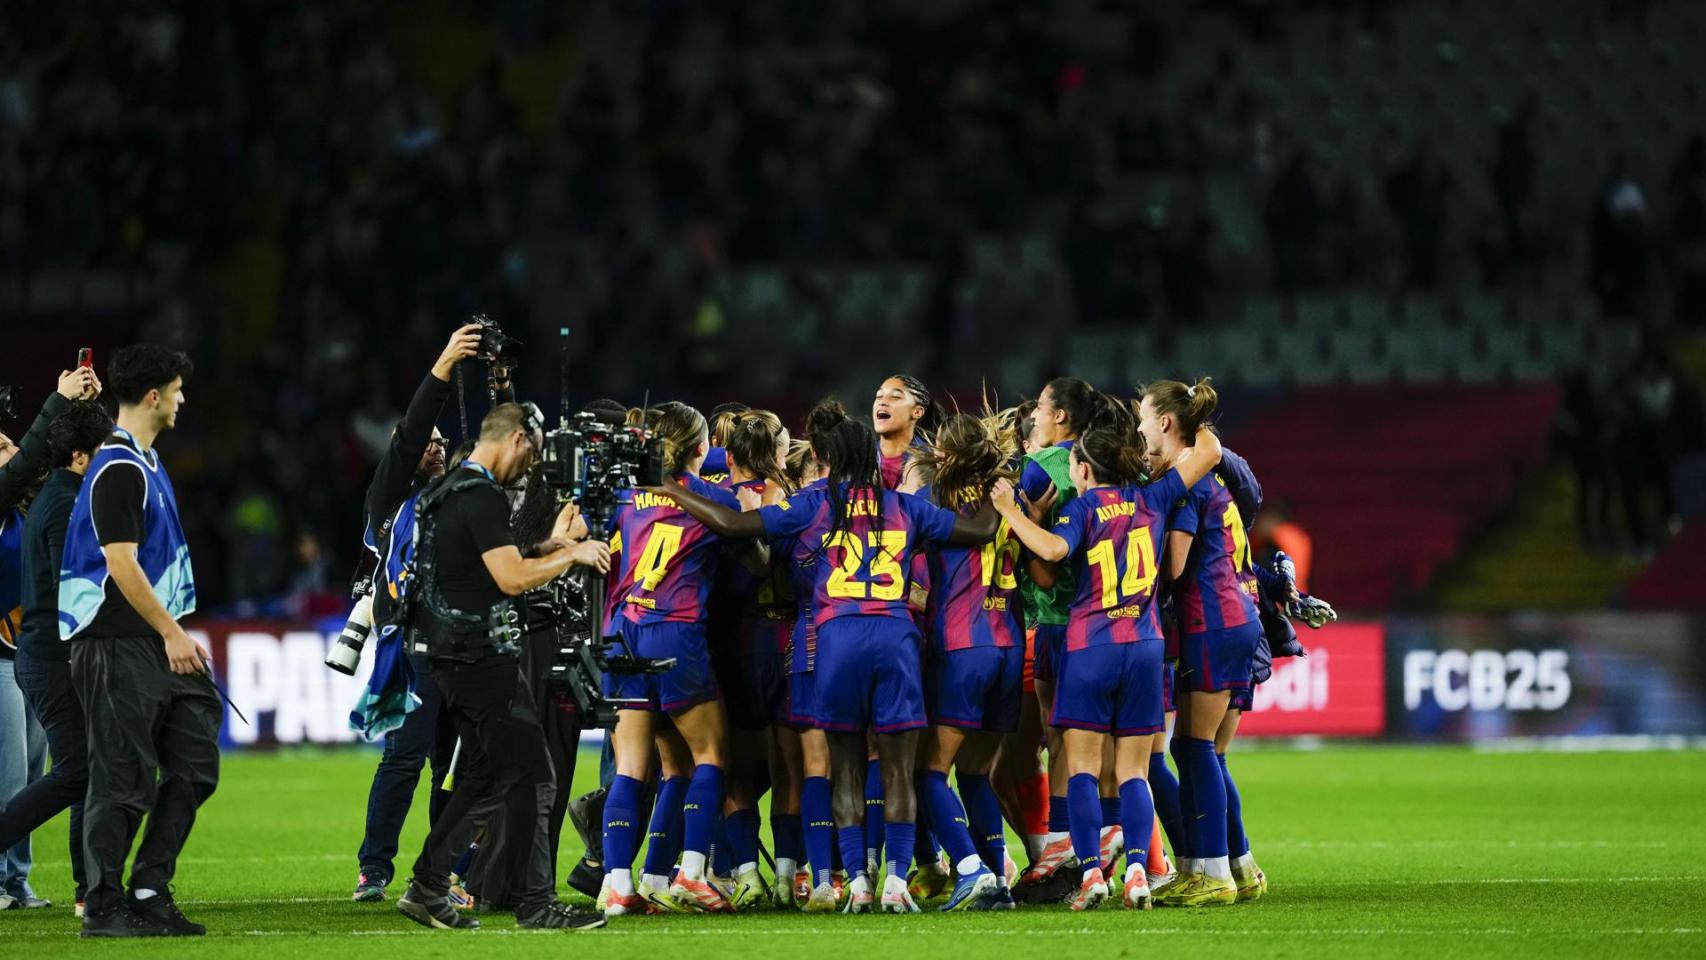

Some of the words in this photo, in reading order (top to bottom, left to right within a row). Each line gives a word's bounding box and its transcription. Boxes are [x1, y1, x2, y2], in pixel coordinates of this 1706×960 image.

[633, 521, 685, 592] 4
[821, 530, 907, 601] 23
[1086, 526, 1158, 609] 14
[1404, 650, 1572, 711] FCB25
